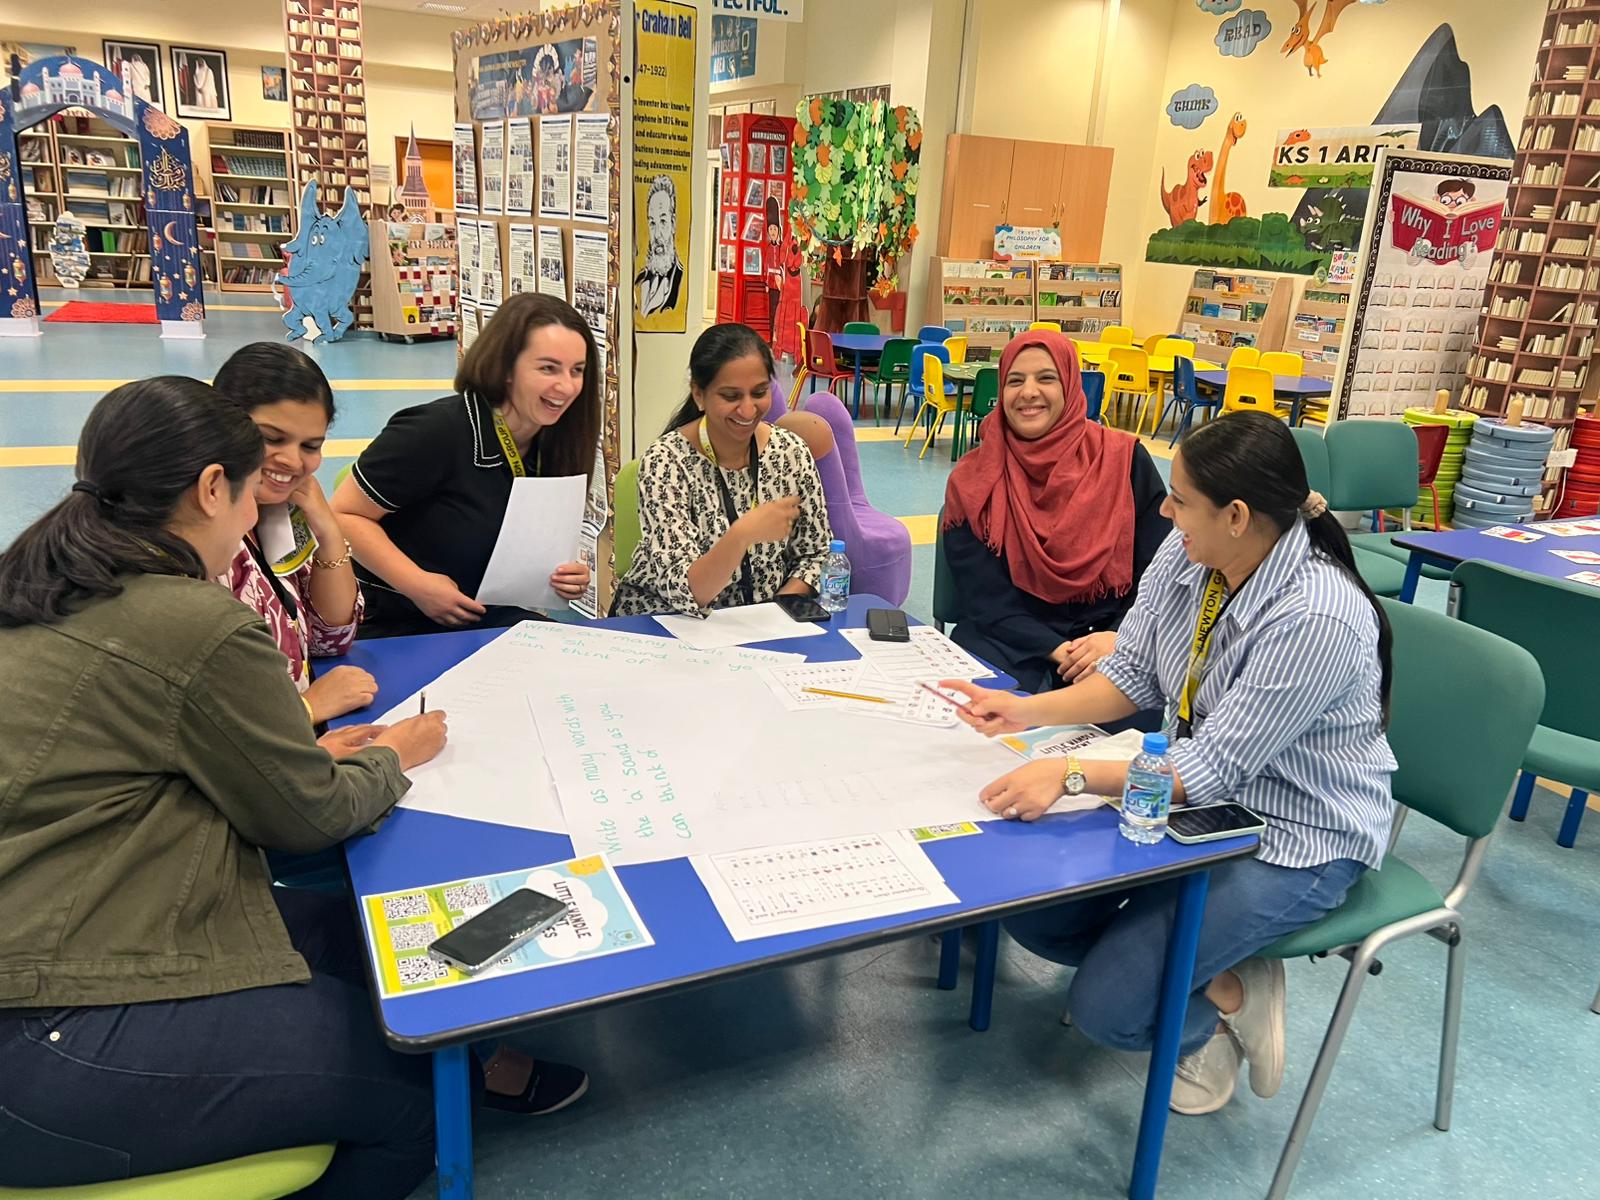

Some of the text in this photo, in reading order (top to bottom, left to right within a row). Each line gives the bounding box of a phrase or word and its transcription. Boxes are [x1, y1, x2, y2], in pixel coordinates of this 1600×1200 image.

[642, 9, 677, 37] Graham
[678, 14, 692, 40] Bell
[1223, 23, 1262, 42] READ
[638, 64, 668, 77] 47-1922)
[1174, 98, 1211, 112] THINK
[1279, 144, 1405, 164] KS 1 AR
[1401, 204, 1495, 239] Why I Love
[498, 426, 516, 458] GROUP
[1198, 589, 1219, 647] NEWTON
[525, 622, 563, 633] Write
[577, 630, 603, 638] as
[612, 634, 667, 648] many
[738, 652, 779, 663] with
[599, 702, 624, 721] you
[606, 727, 623, 739] as
[1040, 742, 1068, 754] LITTLE
[556, 693, 623, 856] Write as many words with
[611, 742, 638, 777] sound
[635, 748, 693, 840] can think of
[634, 814, 655, 839] the
[553, 881, 576, 907] LITTLE
[567, 907, 592, 939] WANDLE
